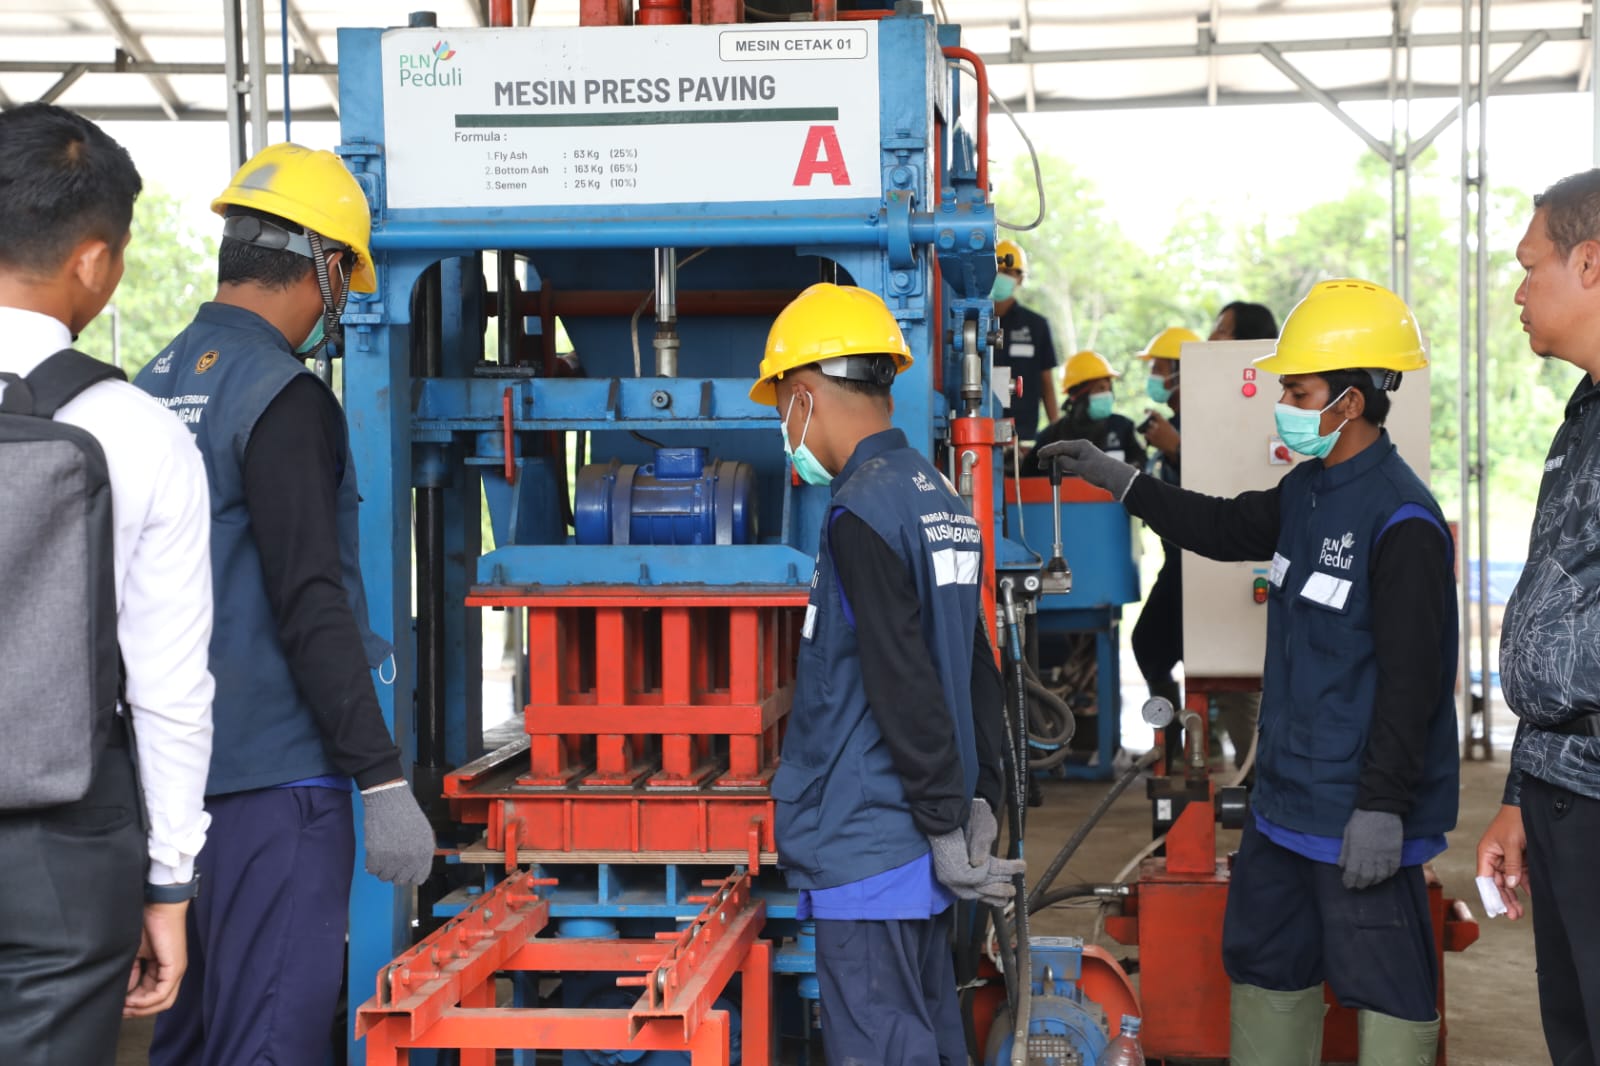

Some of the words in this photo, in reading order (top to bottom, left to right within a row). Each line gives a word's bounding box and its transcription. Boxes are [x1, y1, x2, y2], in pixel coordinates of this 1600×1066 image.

[736, 40, 780, 51] MESIN
[784, 39, 832, 51] CETAK
[837, 39, 851, 50] 01
[399, 54, 430, 68] PLN
[399, 67, 462, 87] Peduli
[494, 80, 576, 106] MESIN
[584, 78, 671, 105] PRESS
[678, 75, 776, 103] PAVING
[454, 131, 501, 142] Formula
[510, 151, 528, 160] Ash
[573, 150, 585, 159] 63
[587, 149, 600, 160] Kg
[609, 148, 638, 159] (25%)
[793, 125, 852, 186] A
[494, 166, 529, 175] Bottom
[531, 165, 549, 174] Ash
[574, 164, 589, 173] 163
[590, 164, 603, 175] Kg
[610, 163, 638, 174] (65%)
[495, 181, 527, 190] Semen
[574, 179, 586, 188] 25
[588, 179, 600, 190] Kg
[610, 178, 637, 188] (10%)
[1245, 369, 1255, 379] R
[1322, 537, 1340, 552] PLN
